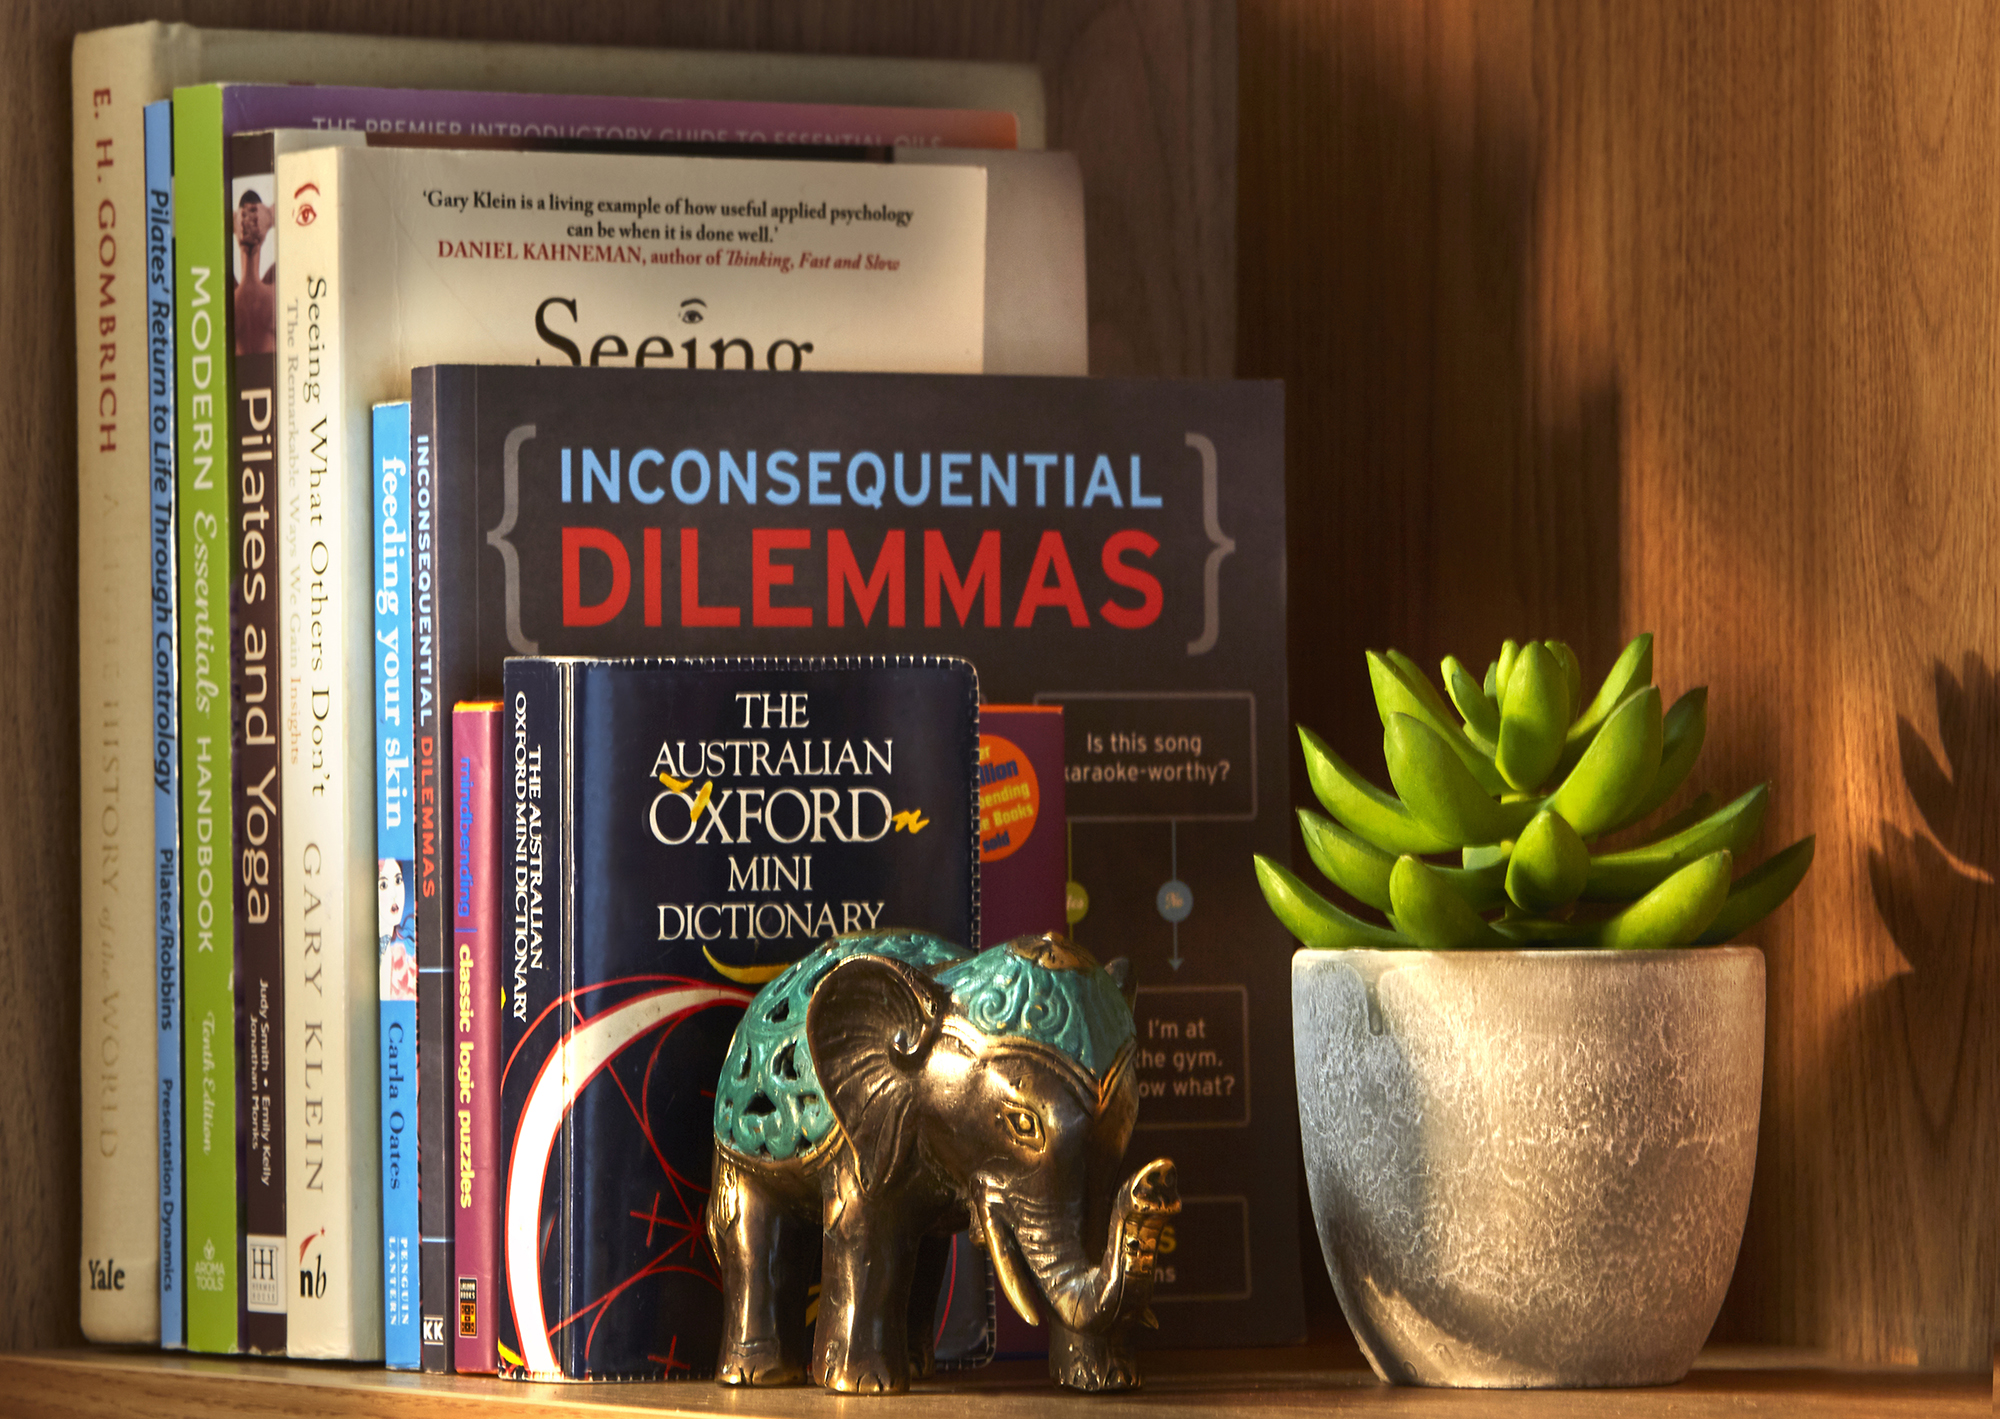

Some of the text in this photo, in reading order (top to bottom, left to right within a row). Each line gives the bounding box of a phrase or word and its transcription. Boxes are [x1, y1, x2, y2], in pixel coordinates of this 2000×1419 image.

[437, 239, 901, 274] DANIEL KAHNEMAN, author of Thinking, Fast and Slow
[473, 190, 516, 210] Klein
[520, 192, 533, 210] is
[537, 199, 546, 211] a
[550, 193, 594, 217] living
[597, 195, 661, 219] example
[664, 197, 684, 215] of
[684, 197, 716, 216] how
[720, 199, 767, 218] useful
[771, 202, 827, 224] applied
[830, 204, 914, 228] psychology
[567, 224, 594, 238] can
[598, 221, 616, 238] be
[619, 222, 660, 240] when
[665, 223, 676, 240] it
[680, 224, 692, 241] is
[696, 224, 734, 242] done
[92, 88, 118, 453] E. H. GOMBRICH
[151, 289, 169, 397] Return
[303, 275, 328, 404] Seeing
[153, 403, 167, 435] to
[154, 443, 172, 494] Life
[308, 414, 328, 527] What
[561, 447, 1163, 510] INCONSEQUENTIAL
[153, 500, 173, 625] Through
[285, 297, 301, 766] The Remarkable Ways We Gain Insights
[561, 526, 1165, 629] DILEMMAS
[190, 266, 220, 952] MODERN Essentials HANDBOOK
[240, 388, 277, 925] Pilates and Yoga
[310, 541, 330, 672] Others
[377, 455, 409, 830] feeding your skin
[154, 634, 176, 795] Controlology
[417, 435, 435, 899] INCONSEQUENTIAL DILEMMAS
[735, 691, 810, 728] THE
[650, 739, 894, 778] AUSTRALIAN
[979, 760, 1019, 786] llion
[1087, 731, 1202, 757] Is this song
[101, 700, 120, 893] HISTORY
[457, 757, 474, 918] mindbending
[649, 787, 893, 845] OXFORD
[979, 782, 1030, 810] bending
[982, 830, 1010, 853] sold
[993, 803, 1034, 827] Books
[514, 690, 528, 1023] OXFORD MINI DICTIONARY
[528, 744, 543, 969] THE AUSTRALIAN
[727, 854, 813, 892] MINI
[159, 848, 176, 1031] Pilates/Robbins
[657, 900, 885, 941] DICTIONARY
[302, 843, 324, 1193] GARY KLEIN
[1148, 1017, 1205, 1039] I'm at
[1173, 1050, 1223, 1072] gym.
[99, 990, 120, 1159] WORLD
[202, 1010, 216, 1155] Tenth Edition
[248, 1013, 260, 1150] Jonathan Monks
[259, 978, 272, 1187] Judy Smith Emily Kelly
[388, 1022, 406, 1190] Carla Oates
[458, 943, 475, 1209] classic logic puzzles
[1139, 1075, 1236, 1098] ow what?
[160, 1078, 175, 1292] Presentation Dynamics
[88, 1258, 126, 1291] Yale
[194, 1260, 225, 1276] AROMA
[195, 1276, 225, 1292] TOOLS
[388, 1236, 398, 1326] LANTERN
[400, 1237, 409, 1326] PENGUIN
[422, 1321, 444, 1342] KK
